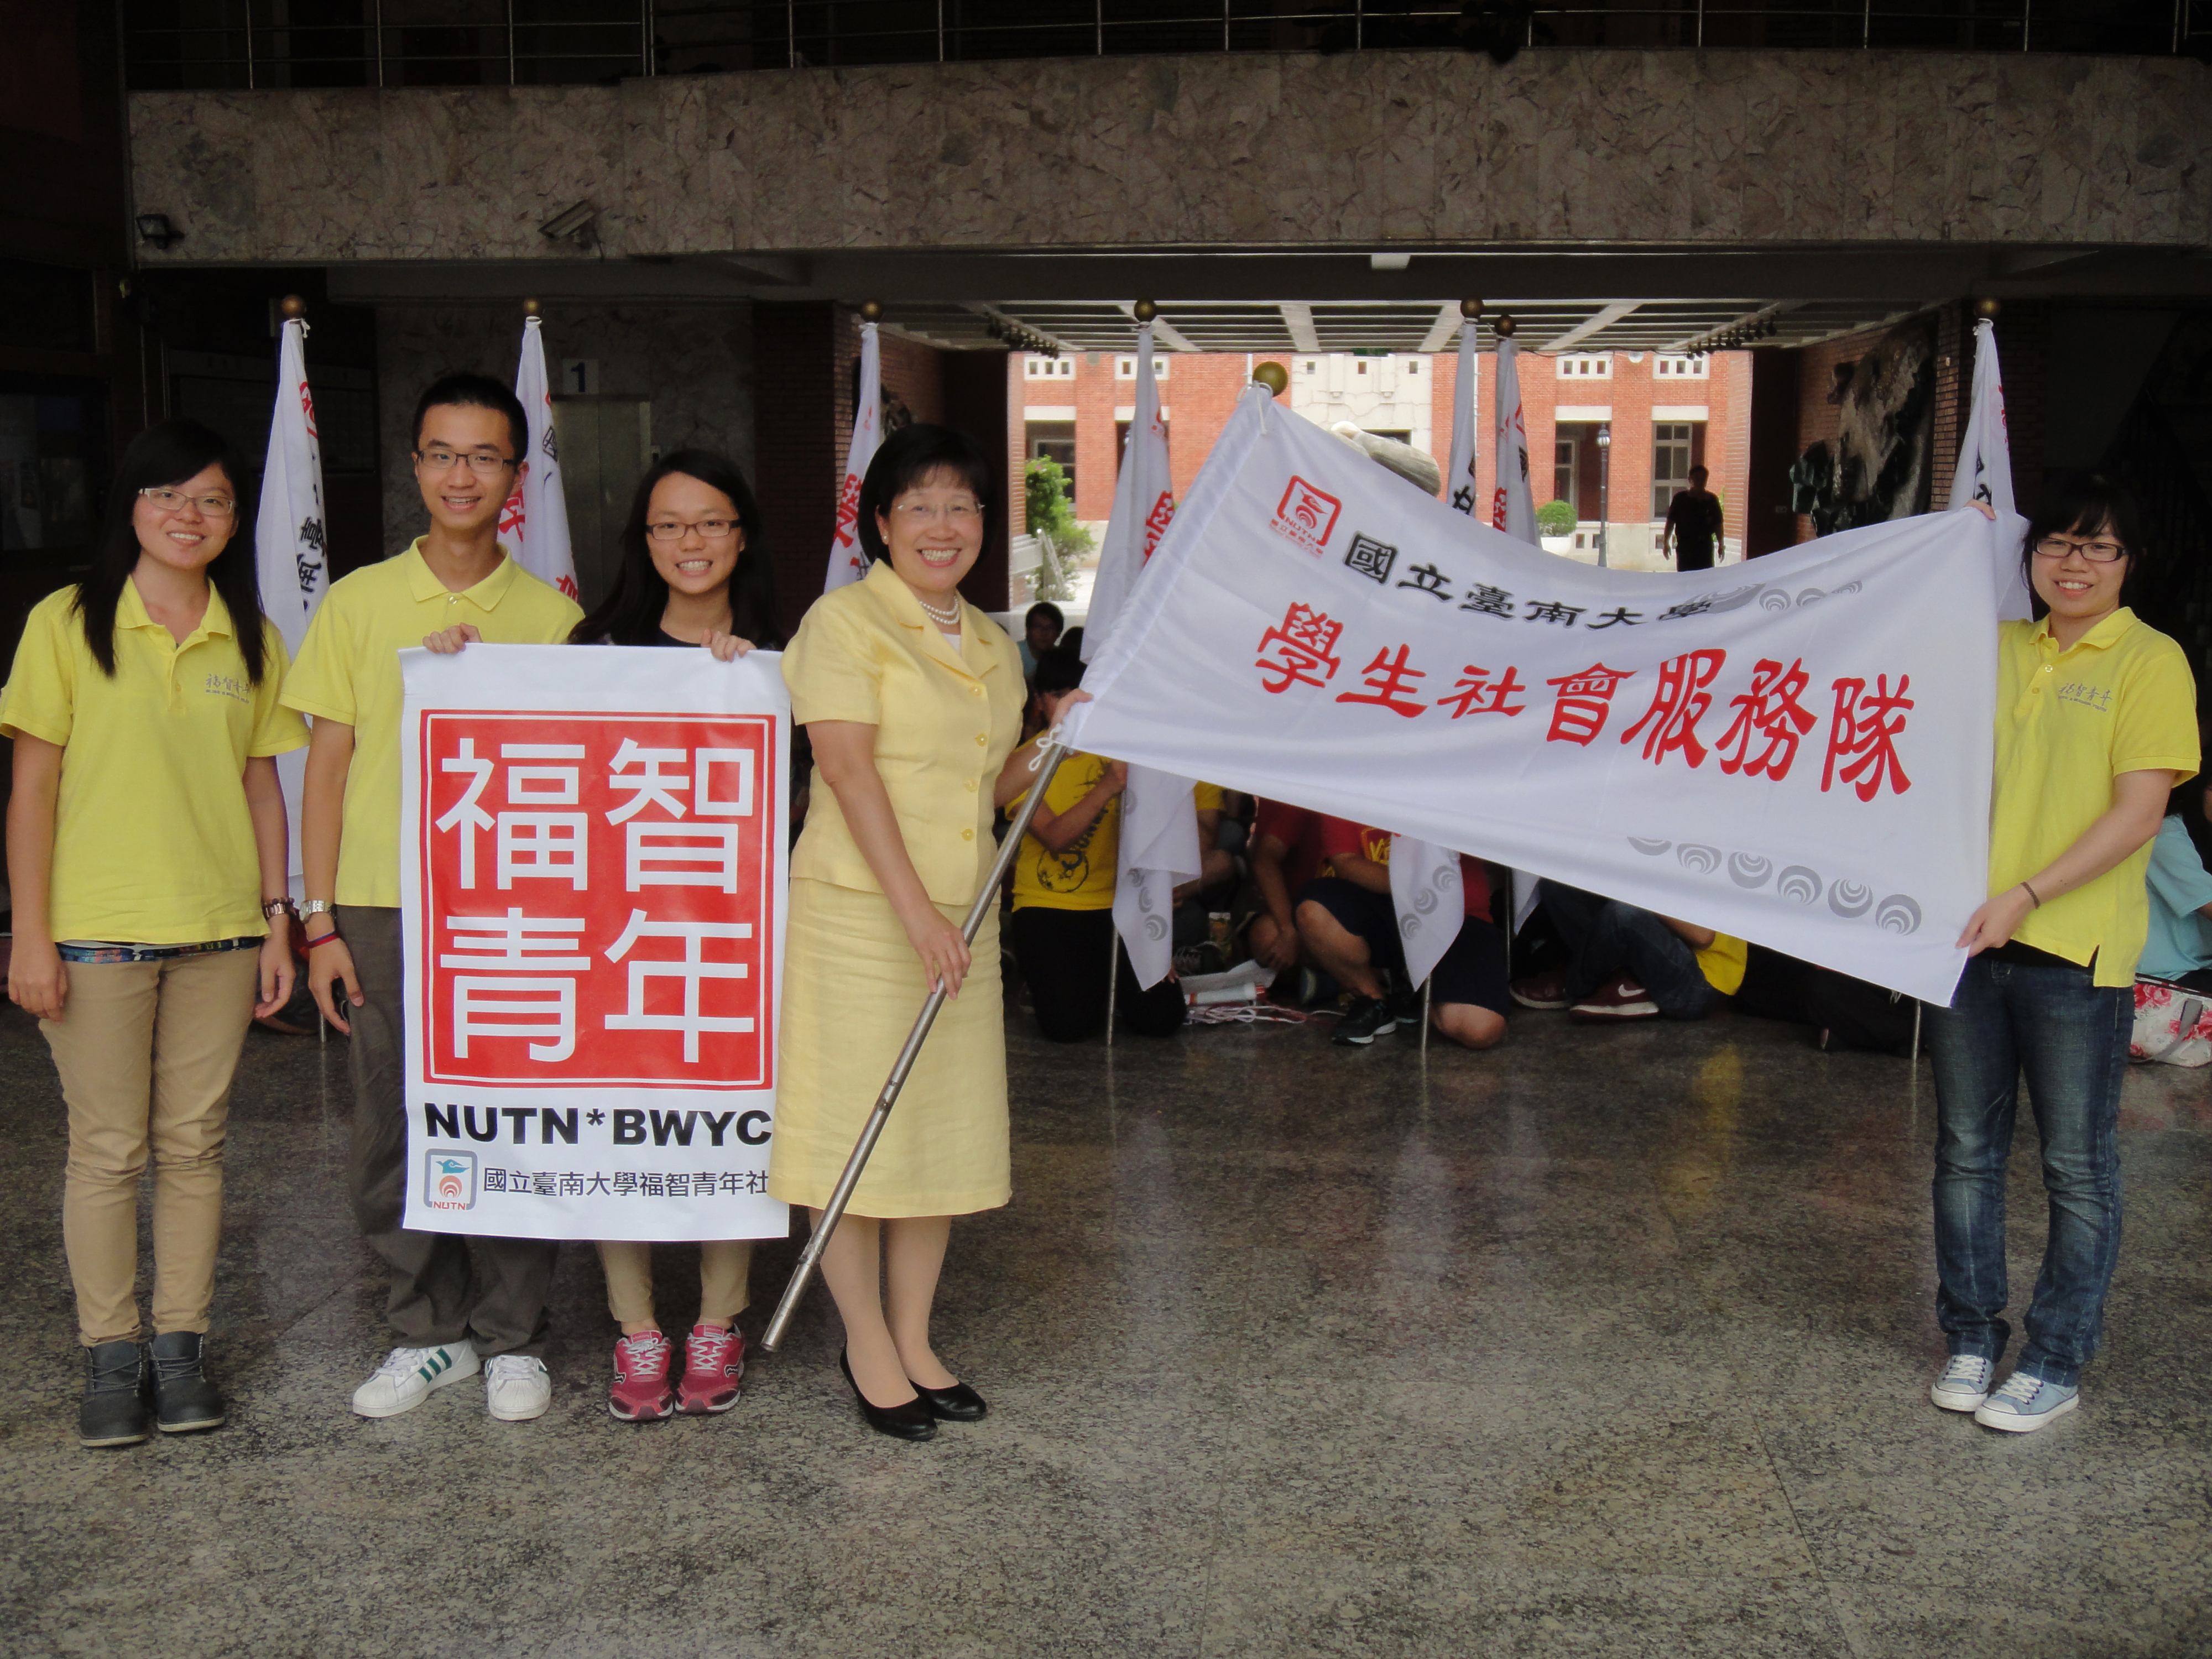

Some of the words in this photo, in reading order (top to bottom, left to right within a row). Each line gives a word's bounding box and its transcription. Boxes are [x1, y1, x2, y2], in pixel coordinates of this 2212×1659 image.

[571, 362, 586, 393] 1
[1255, 602, 1915, 802] 學生社會服務隊
[435, 737, 755, 894] 福智
[440, 907, 755, 1063] 青年
[433, 1202, 466, 1211] NUTN
[483, 1166, 768, 1198] 國立臺南大學福智青年社
